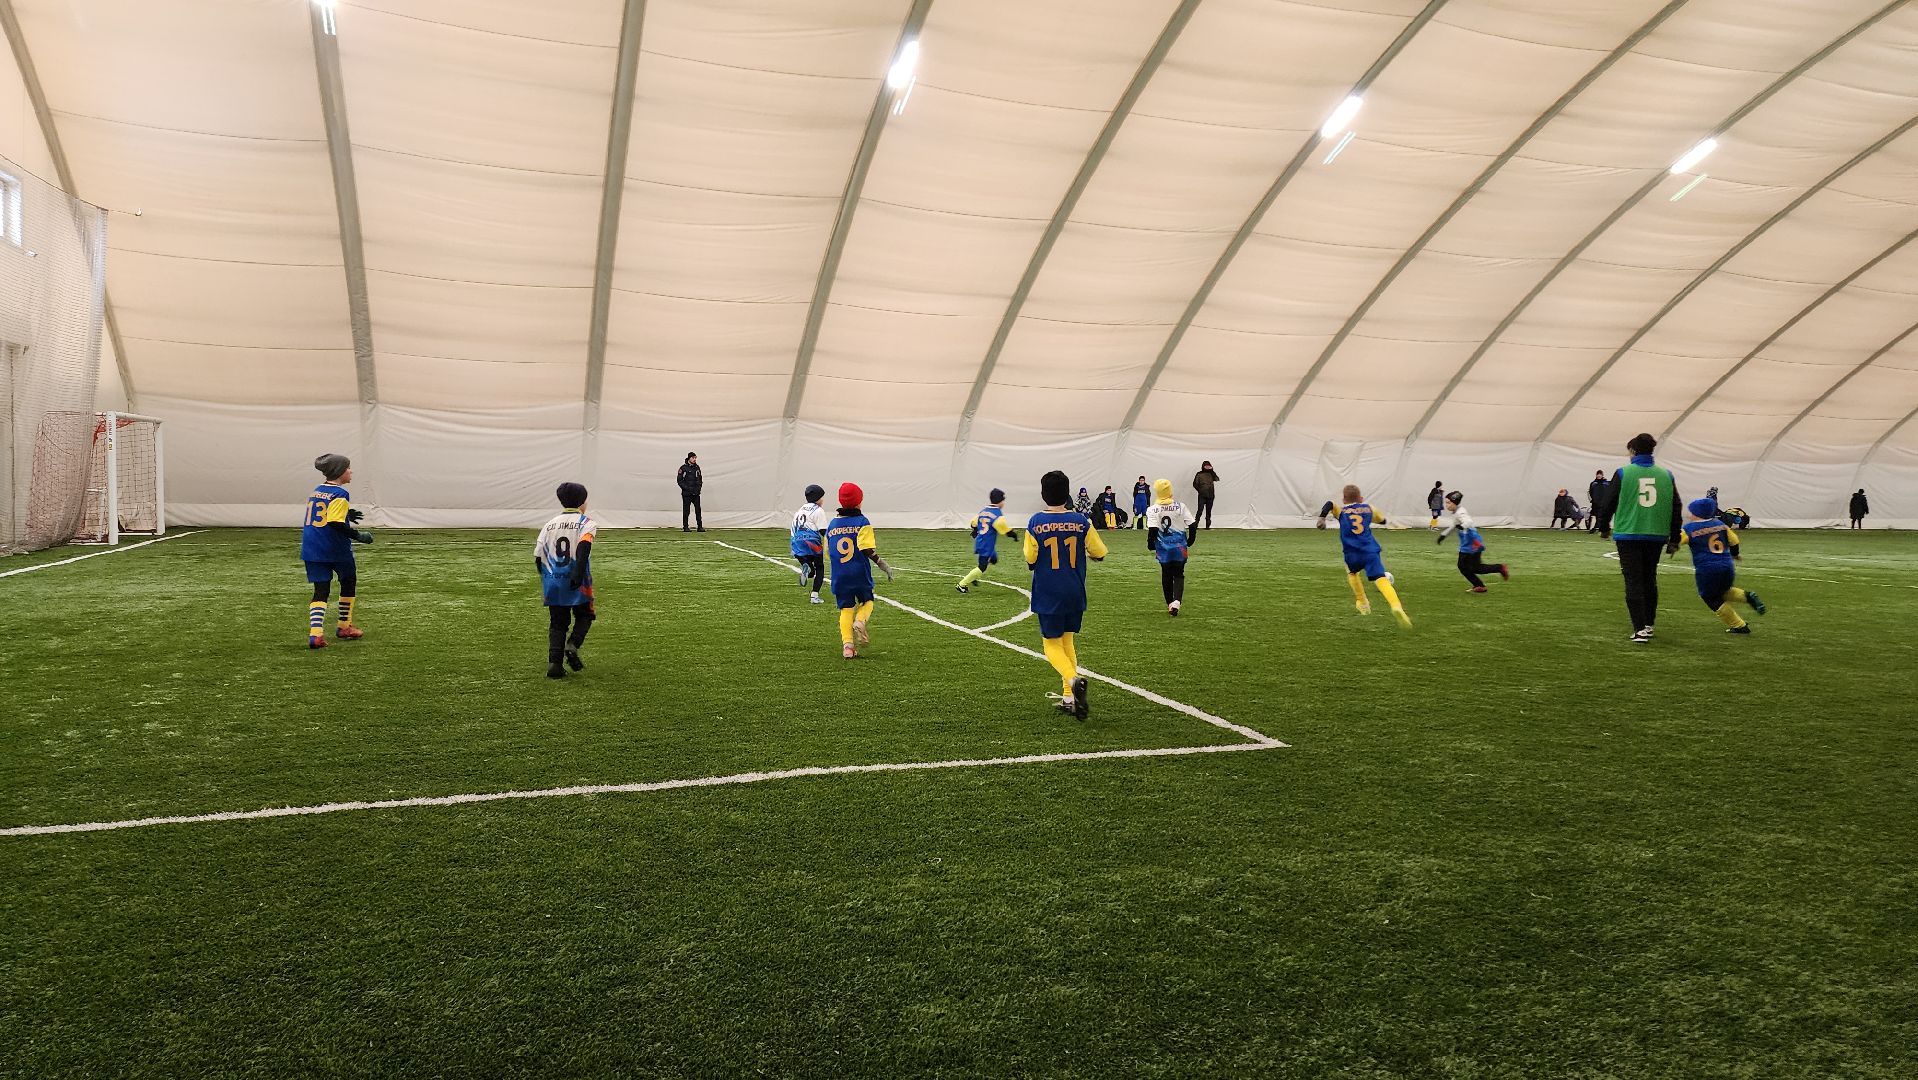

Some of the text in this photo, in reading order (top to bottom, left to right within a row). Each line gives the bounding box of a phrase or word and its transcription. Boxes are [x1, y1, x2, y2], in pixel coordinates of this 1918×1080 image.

[1638, 477, 1657, 507] 5
[305, 501, 328, 528] 13
[1349, 514, 1364, 535] 3
[555, 536, 571, 568] 9
[836, 537, 855, 564] 9
[1043, 536, 1078, 570] 11
[1708, 533, 1724, 554] 6
